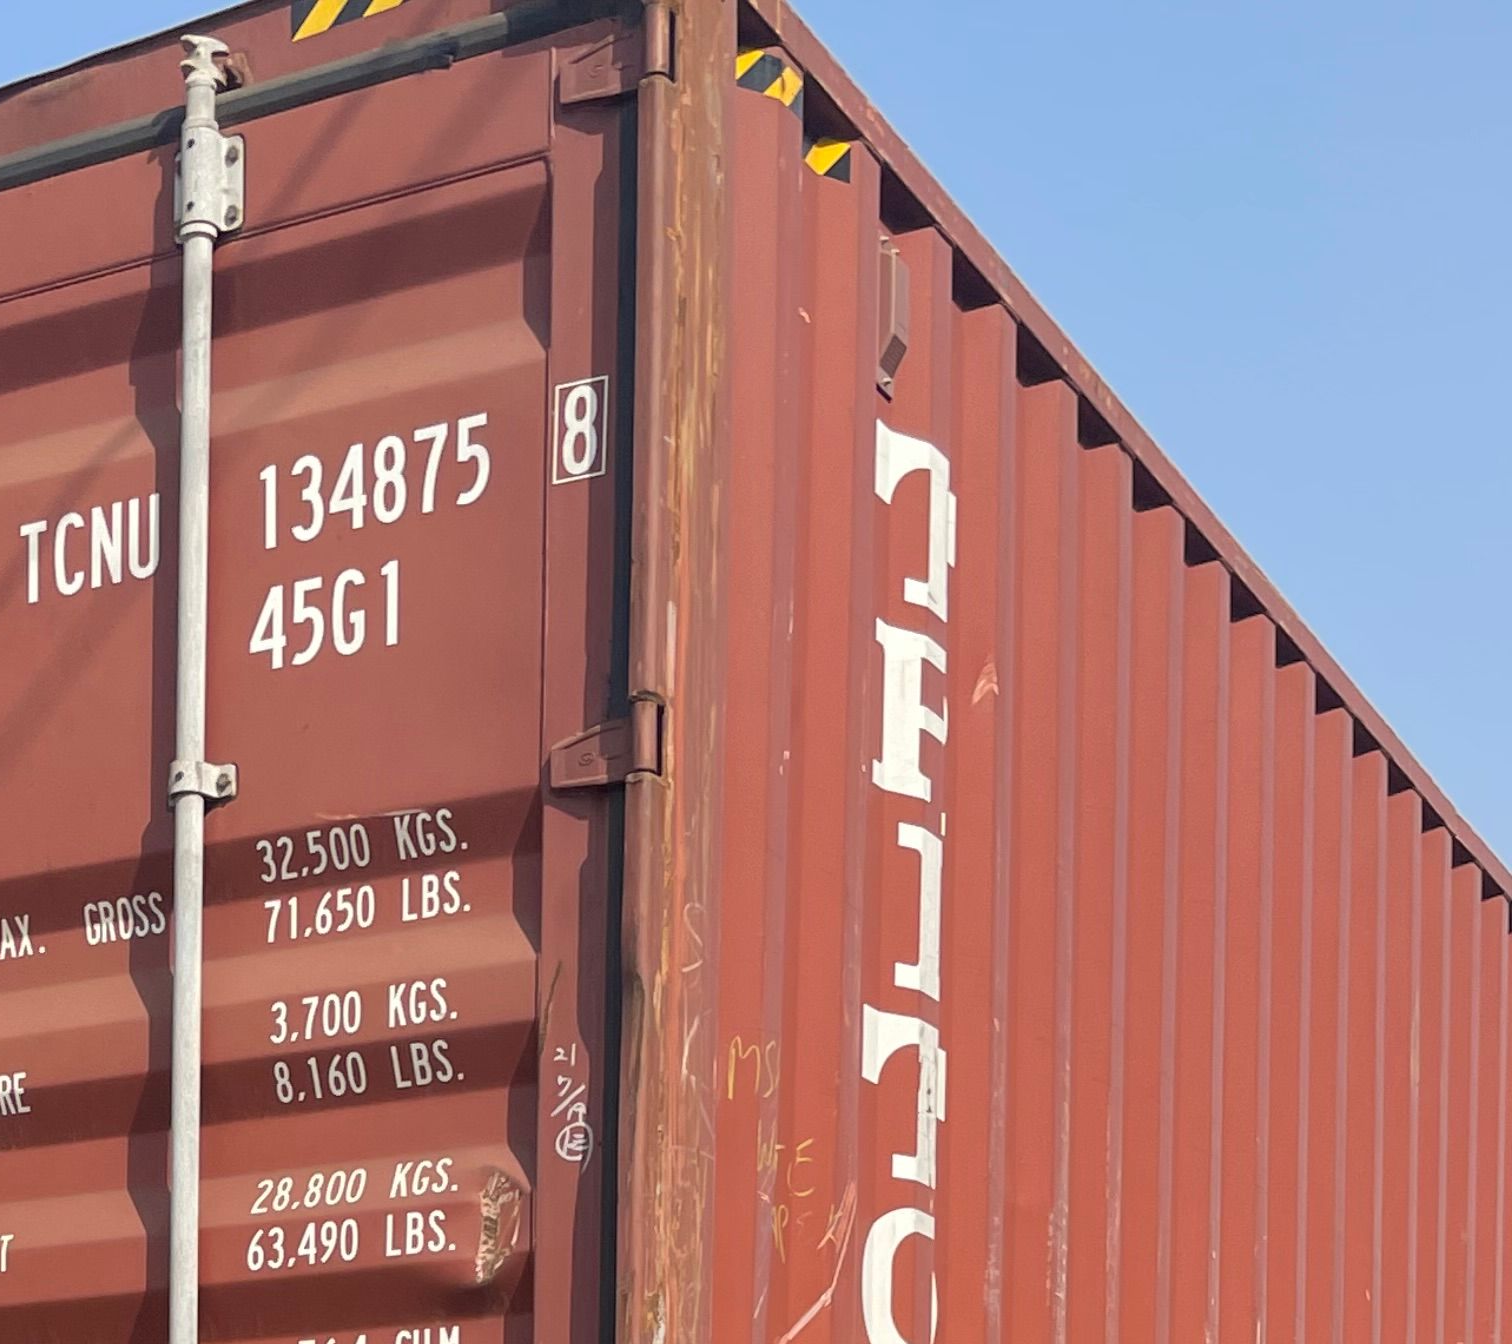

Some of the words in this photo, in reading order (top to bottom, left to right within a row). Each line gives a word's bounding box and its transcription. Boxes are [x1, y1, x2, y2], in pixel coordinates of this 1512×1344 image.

[20, 491, 162, 604] TCNU
[259, 412, 490, 549] 134875
[562, 385, 600, 475] 8
[249, 559, 401, 670] 45G1
[393, 807, 468, 861] KGS.
[83, 891, 167, 946] GROSS
[401, 870, 471, 922] LBS.
[388, 977, 458, 1028] KGS.
[390, 1038, 465, 1090] LBS.
[389, 1157, 459, 1199] KGS.
[384, 1209, 457, 1257] LBS.
